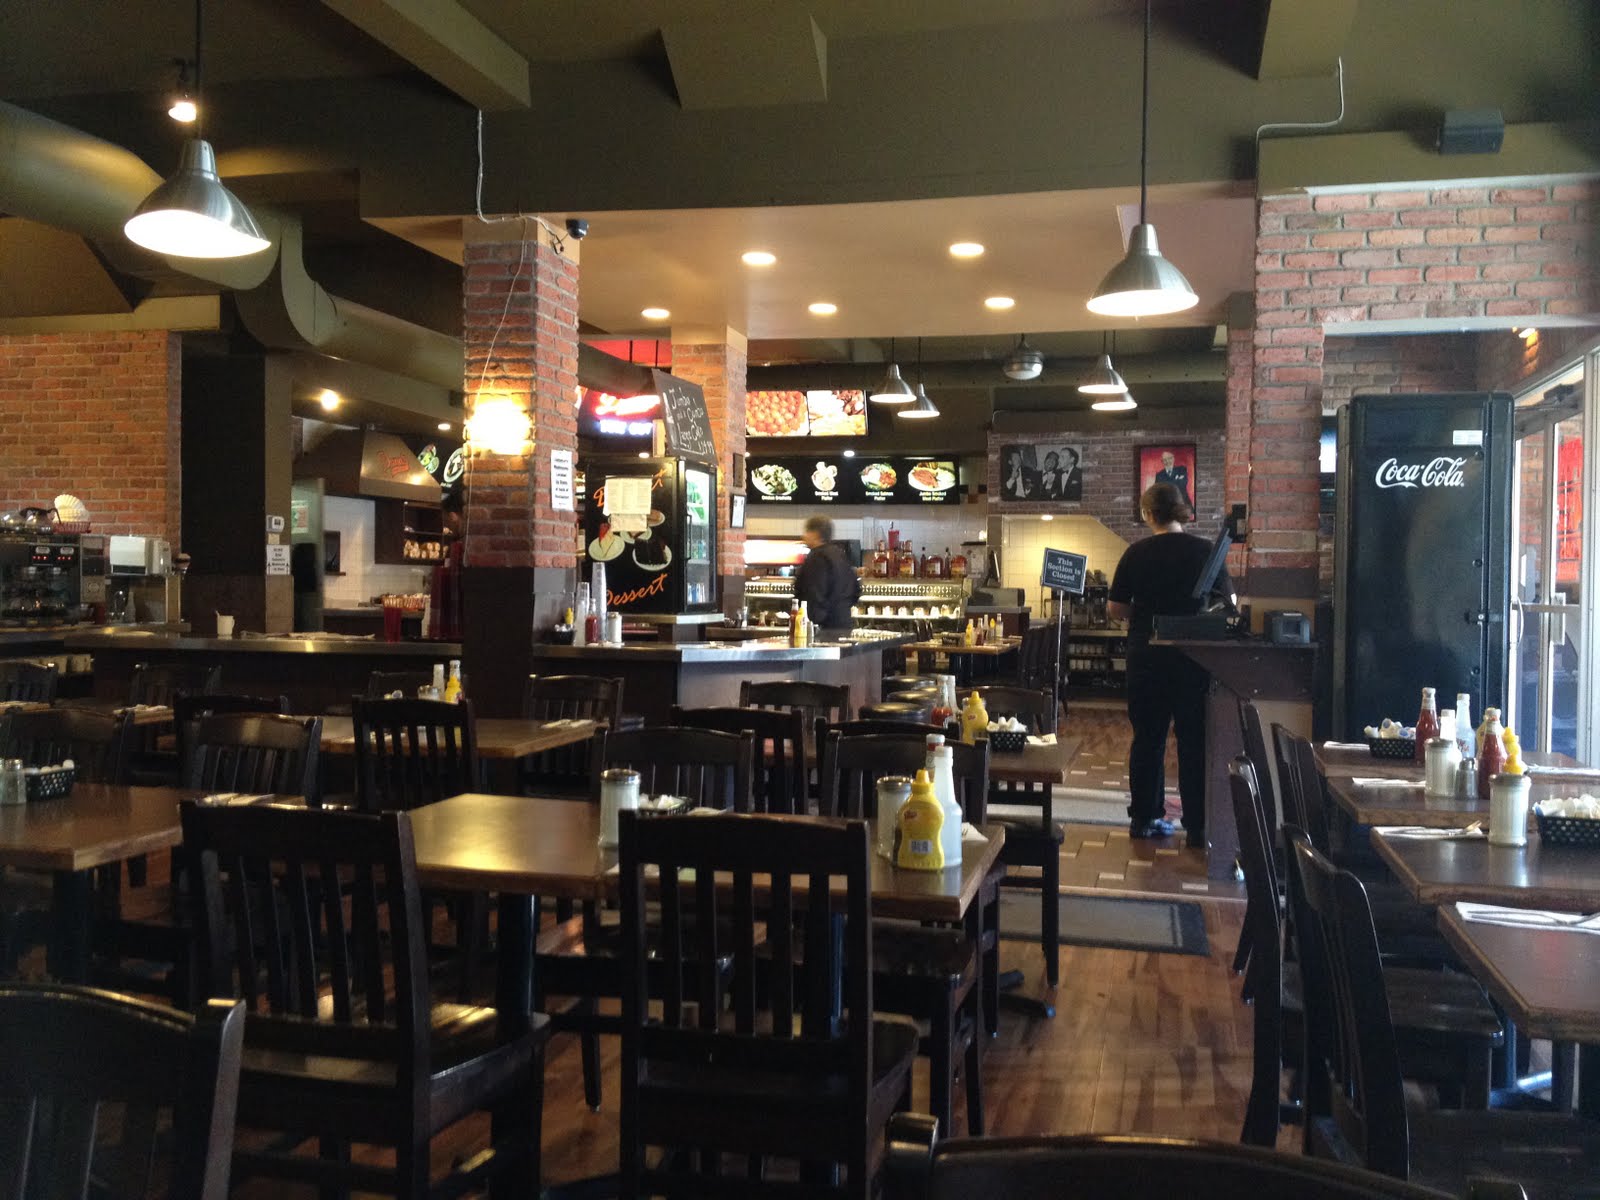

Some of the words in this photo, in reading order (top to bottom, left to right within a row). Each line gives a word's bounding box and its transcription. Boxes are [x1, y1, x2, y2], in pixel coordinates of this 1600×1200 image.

[1375, 457, 1467, 488] Coca-Cola
[1057, 557, 1073, 567] This
[1047, 562, 1073, 575] Section
[1051, 570, 1075, 581] Closed
